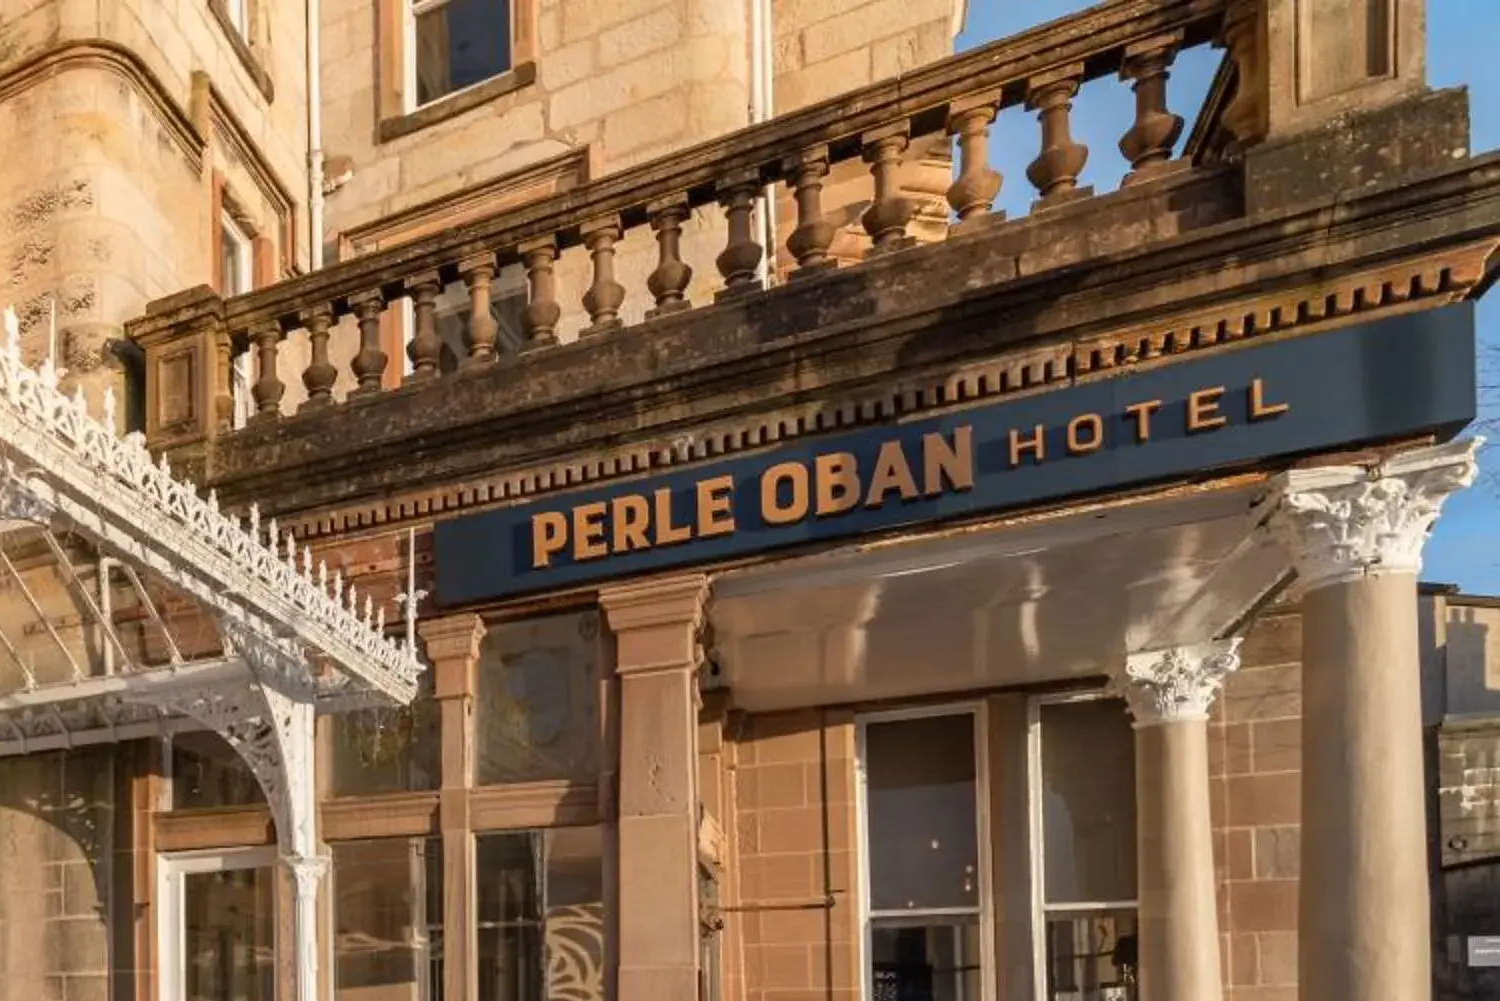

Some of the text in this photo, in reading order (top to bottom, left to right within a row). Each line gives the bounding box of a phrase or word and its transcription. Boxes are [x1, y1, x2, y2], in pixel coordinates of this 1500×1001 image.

[531, 377, 1291, 569] PERLE OBAN HOTEL
